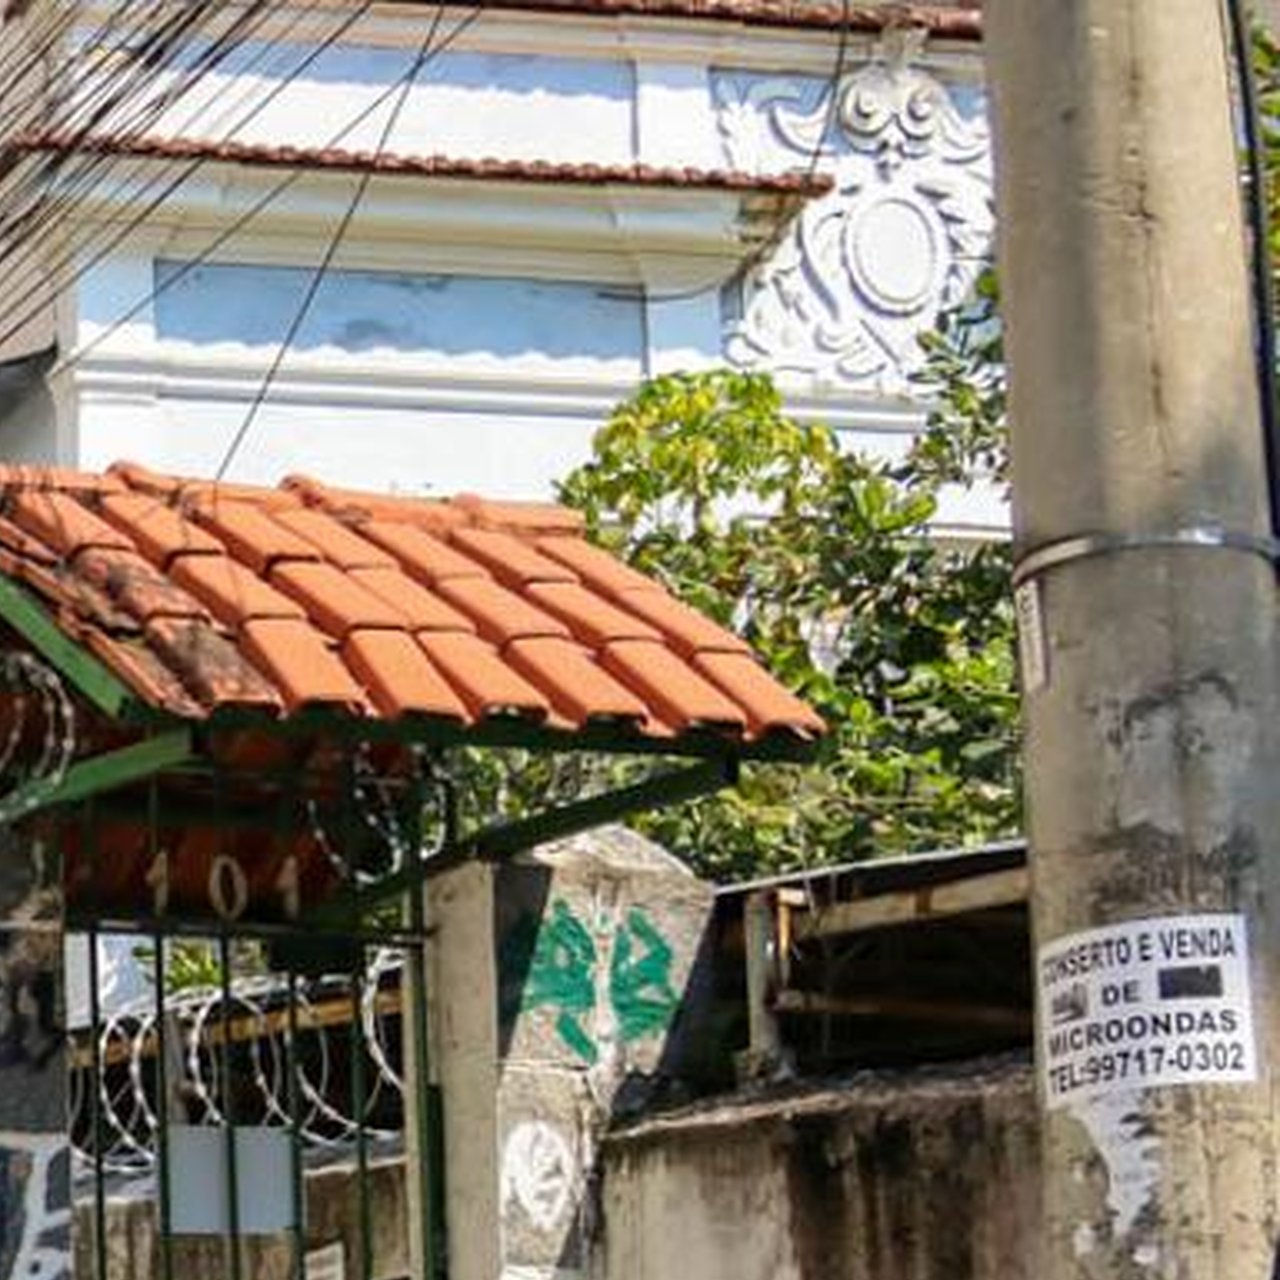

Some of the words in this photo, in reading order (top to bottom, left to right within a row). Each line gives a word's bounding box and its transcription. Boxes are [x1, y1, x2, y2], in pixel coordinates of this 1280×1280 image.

[145, 851, 299, 919] 101
[1137, 932, 1152, 962] E
[1159, 927, 1236, 960] VENDA
[1101, 979, 1140, 1006] DE
[1048, 1008, 1239, 1058] MICROONDAS
